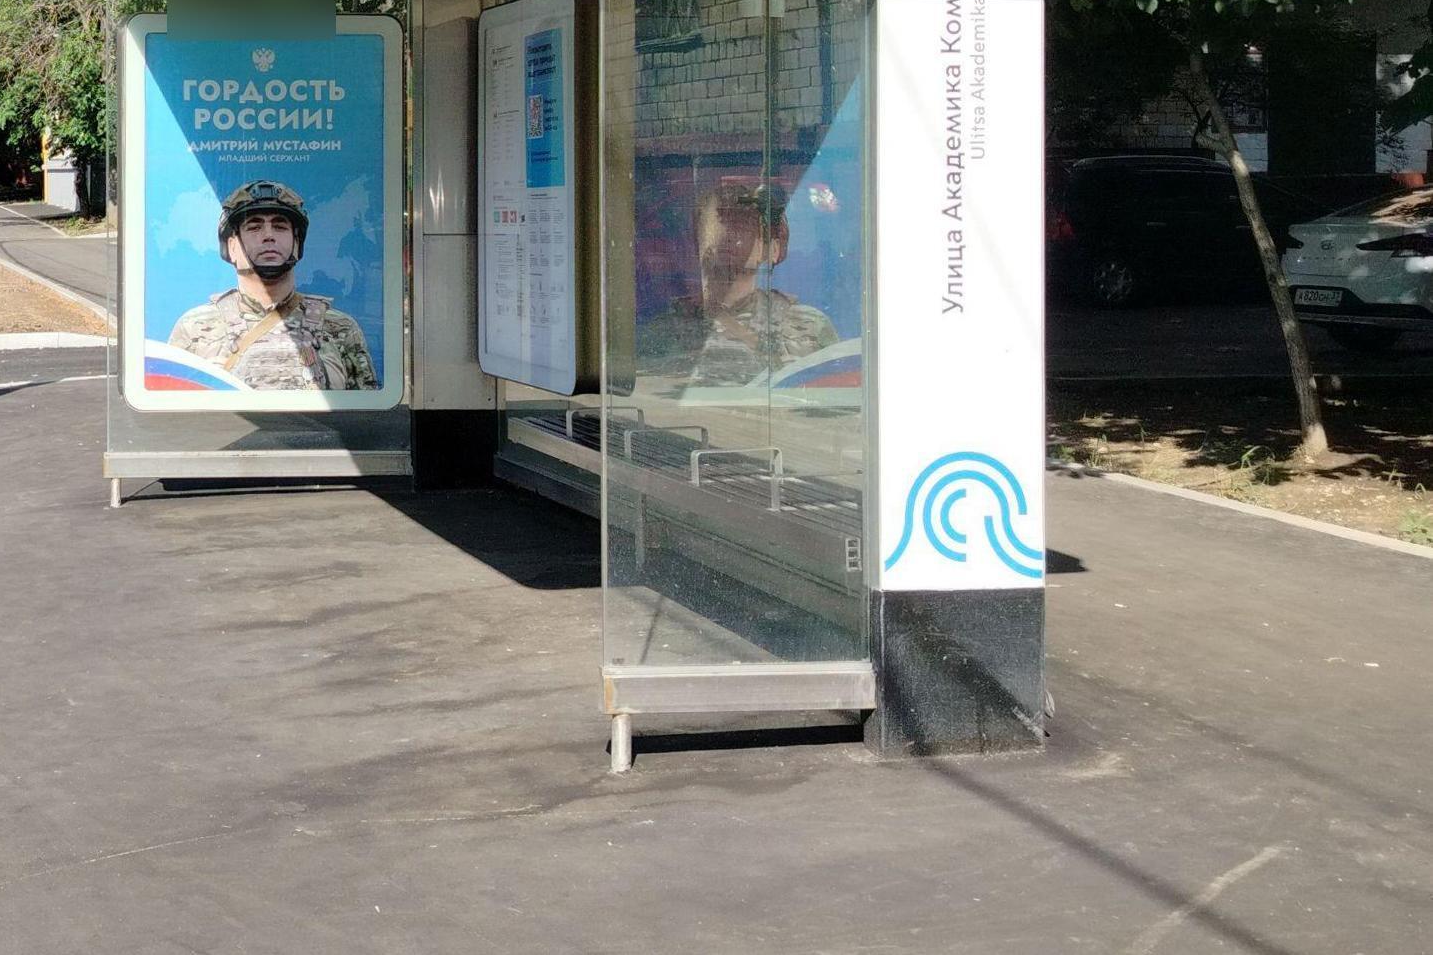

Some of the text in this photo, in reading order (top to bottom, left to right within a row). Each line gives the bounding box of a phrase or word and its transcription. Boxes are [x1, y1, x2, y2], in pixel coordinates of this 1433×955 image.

[183, 79, 345, 104] ГОРДОСТЬ
[194, 108, 333, 130] РОССИИ!
[189, 138, 342, 152] ДМИТРИЙ МУСТАФИН
[941, 64, 965, 222] Академика
[969, 106, 985, 159] Ulitsa
[218, 153, 311, 163] МЛАДШИЙ СЕРЖАНТ
[942, 229, 966, 314] Улица
